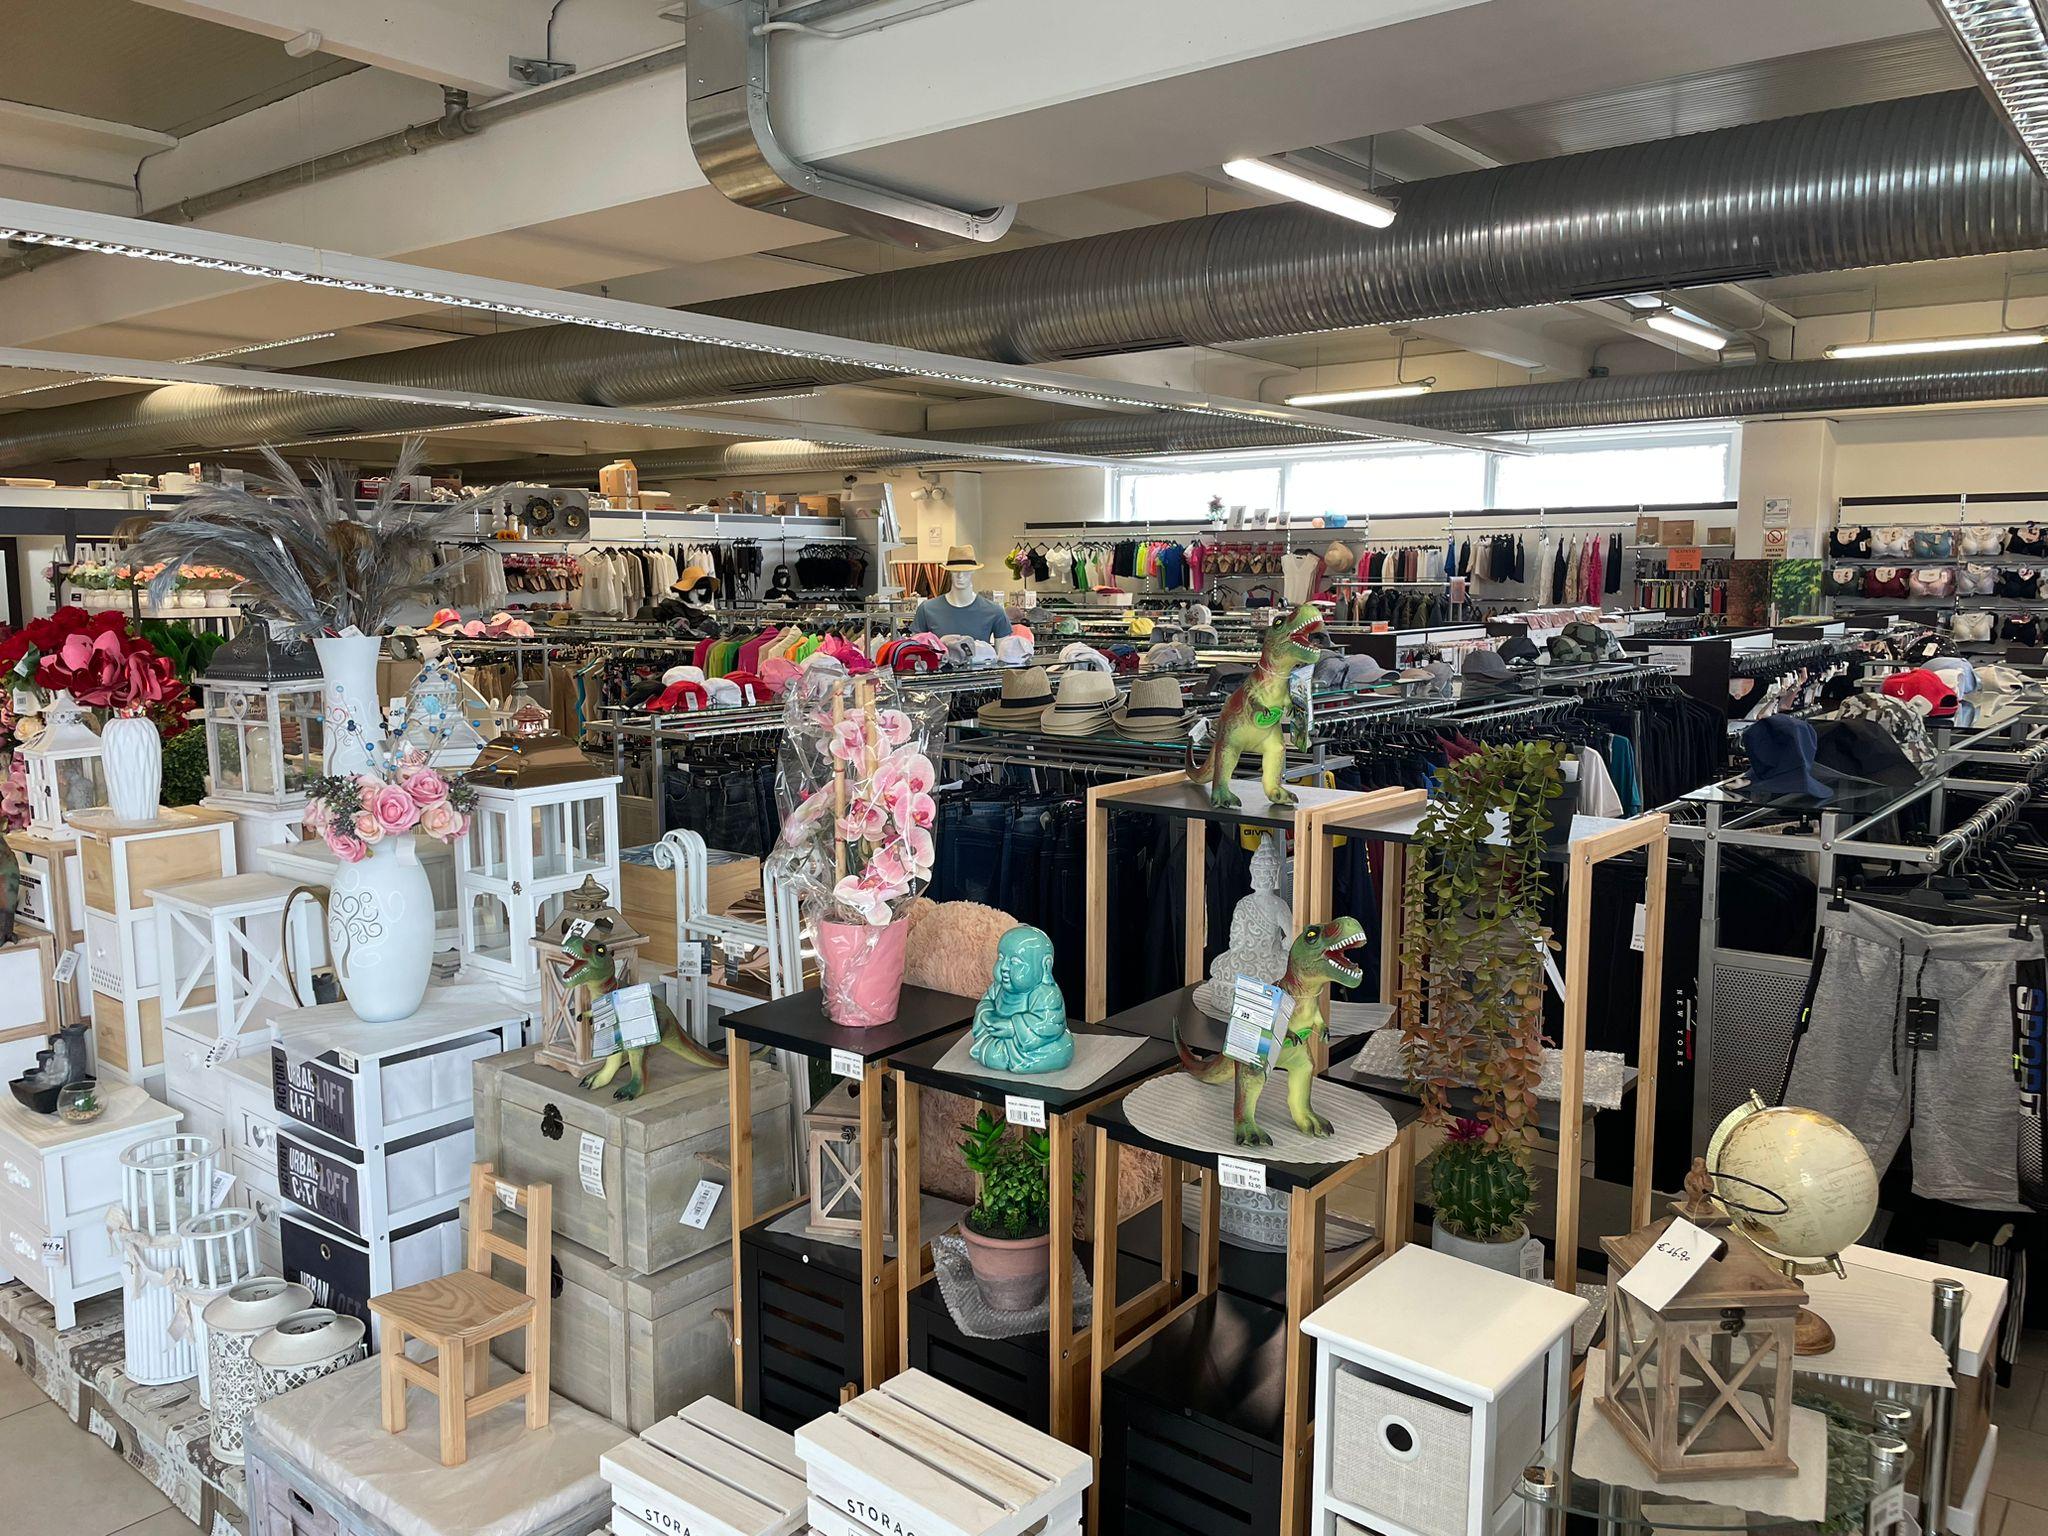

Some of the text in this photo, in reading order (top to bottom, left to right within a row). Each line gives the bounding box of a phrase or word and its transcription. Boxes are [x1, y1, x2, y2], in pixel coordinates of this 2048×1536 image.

[1676, 989, 1684, 1067] NEW YORK
[2016, 986, 2046, 1118] SPORT
